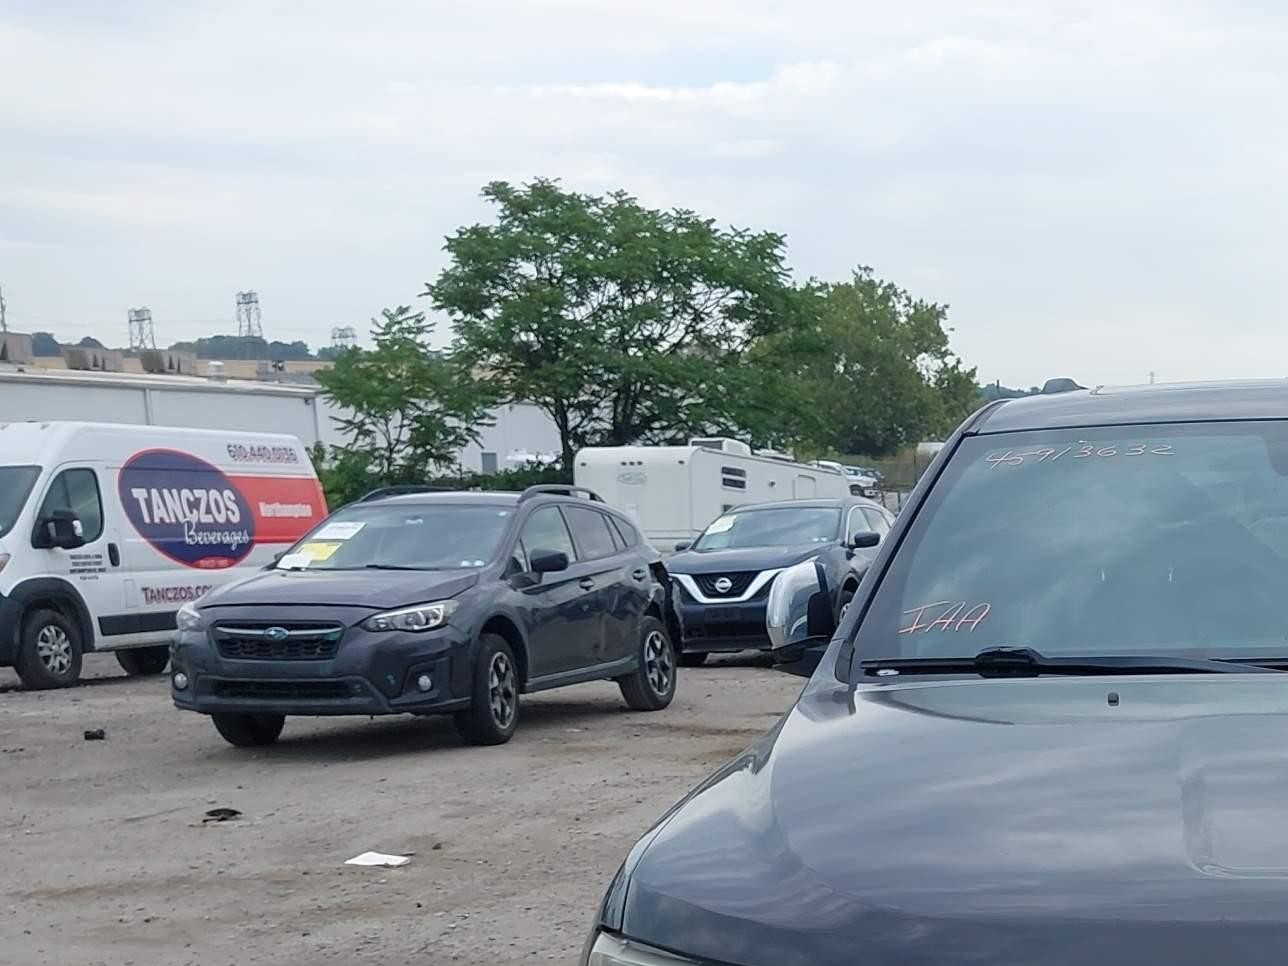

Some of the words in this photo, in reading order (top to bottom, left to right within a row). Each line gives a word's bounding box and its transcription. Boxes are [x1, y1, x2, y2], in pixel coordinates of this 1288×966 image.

[984, 443, 1176, 470] 45913632
[131, 488, 240, 524] TANCZOS
[184, 518, 250, 551] Beverages
[141, 584, 213, 605] TANCZOS.CO
[898, 600, 991, 634] IAA
